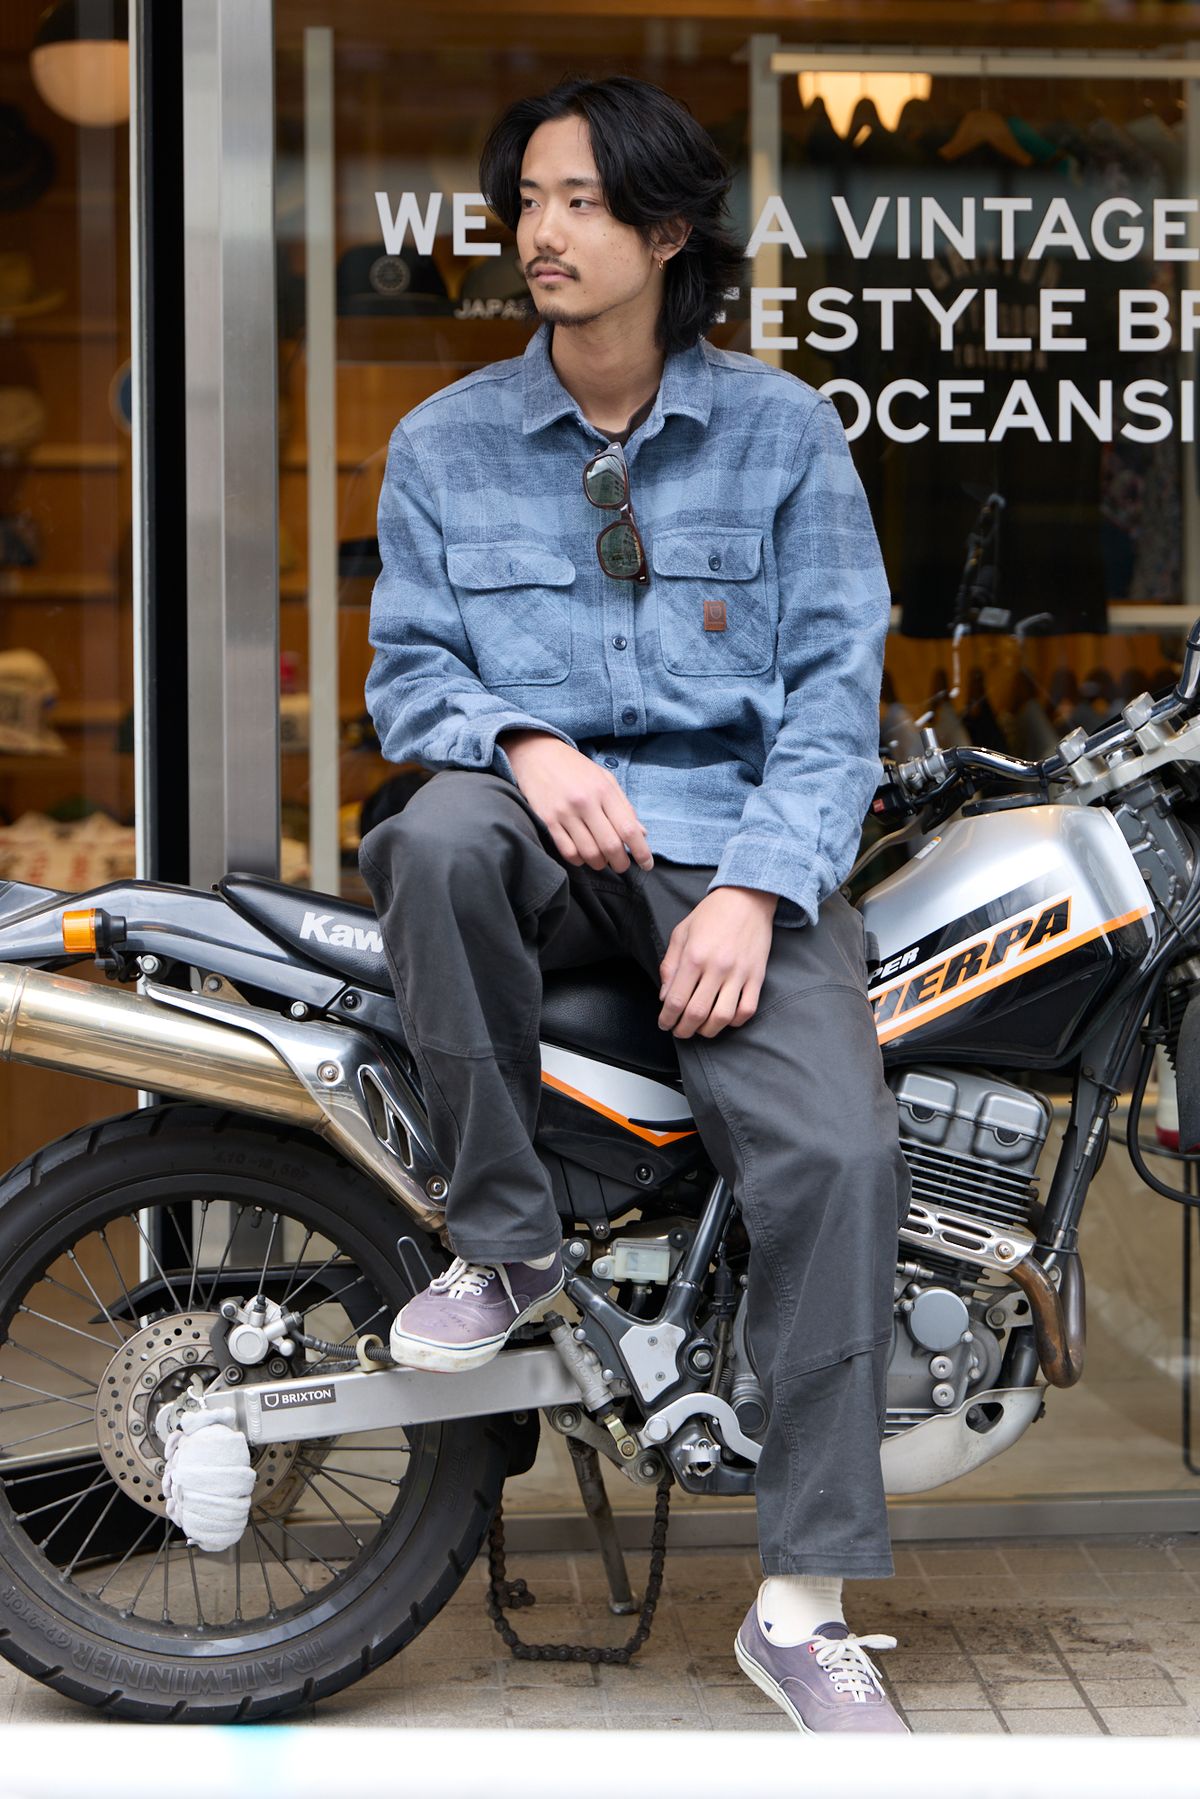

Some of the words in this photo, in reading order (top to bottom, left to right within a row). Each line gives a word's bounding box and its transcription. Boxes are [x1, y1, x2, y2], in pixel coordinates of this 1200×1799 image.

[375, 191, 501, 257] WE
[744, 195, 808, 259] A
[831, 196, 1200, 262] VINTAGE
[281, 1389, 332, 1404] BRIXTON
